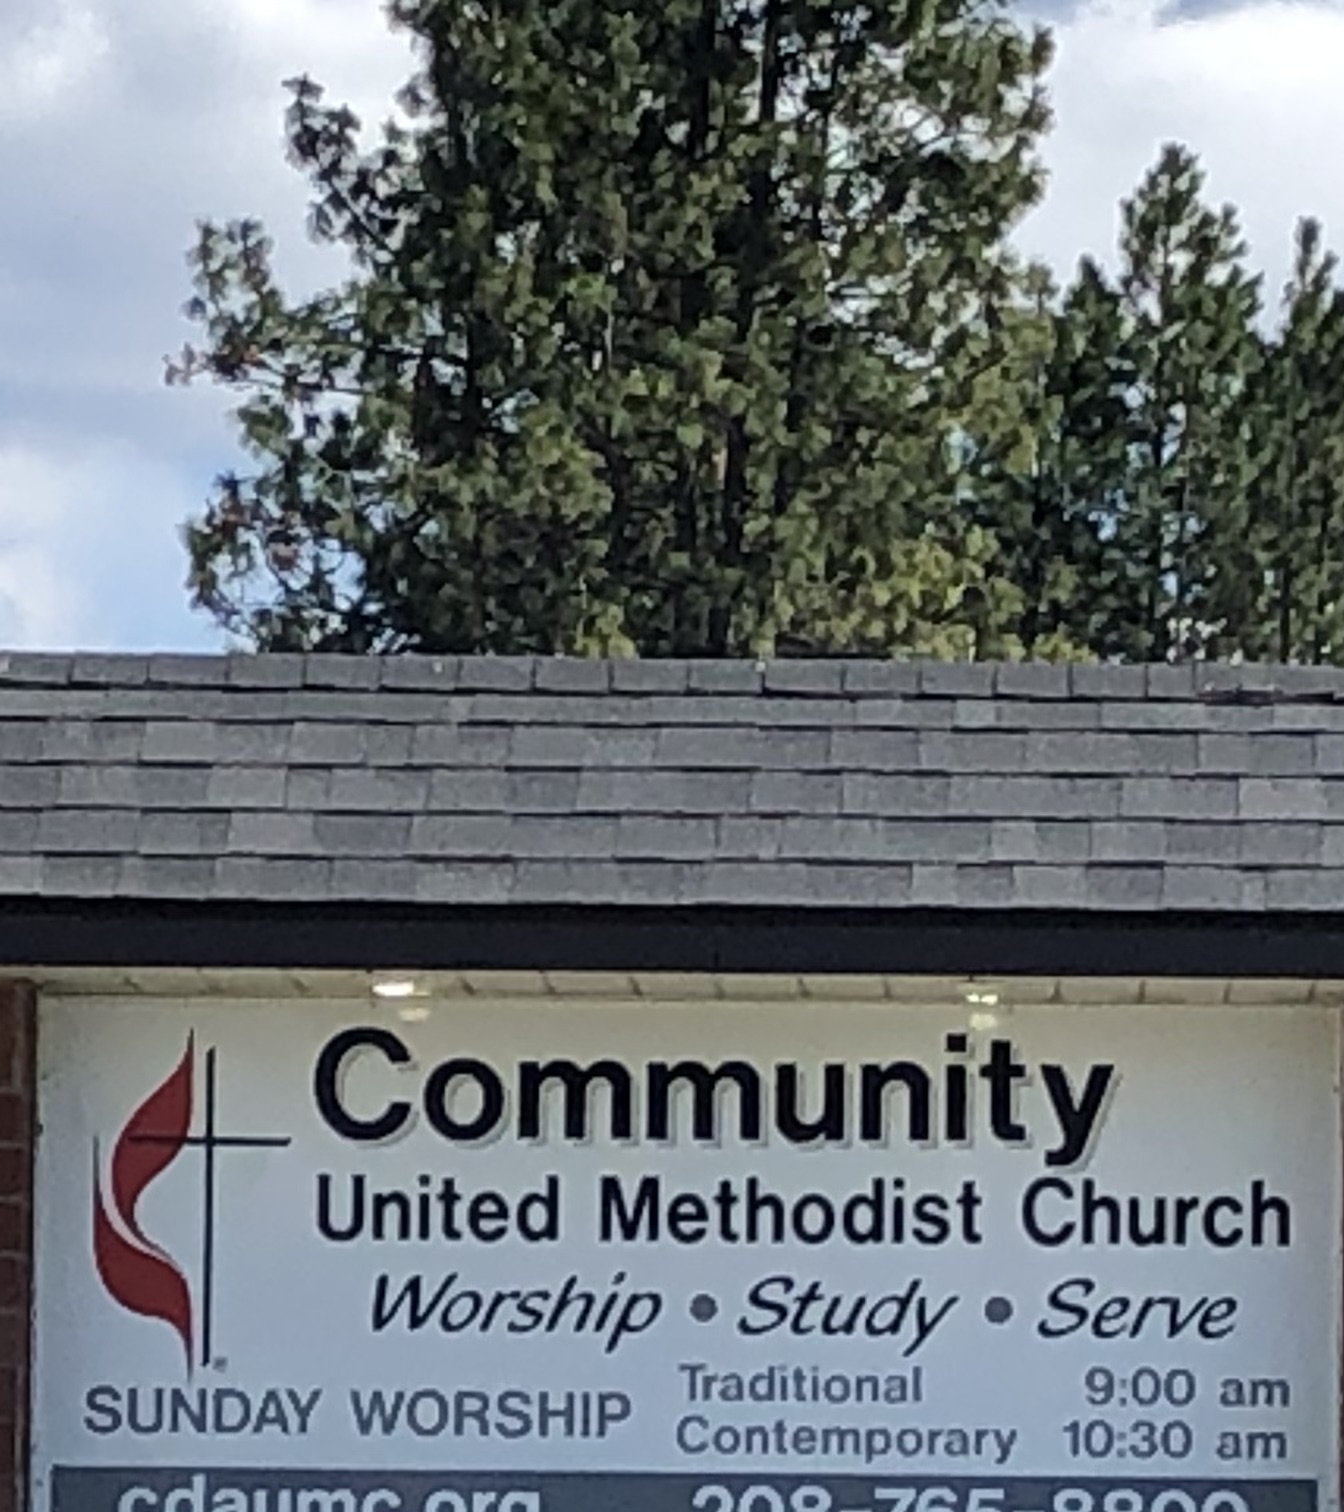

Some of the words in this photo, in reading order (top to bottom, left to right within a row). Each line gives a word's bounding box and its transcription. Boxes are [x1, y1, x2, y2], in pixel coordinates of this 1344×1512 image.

[314, 1027, 1115, 1167] Community
[317, 1173, 559, 1243] United
[600, 1175, 982, 1245] Methodist
[1022, 1176, 1291, 1248] Church
[372, 1271, 663, 1354] Worship
[737, 1276, 959, 1358] Study
[1037, 1278, 1238, 1340] Serve
[83, 1385, 322, 1435] SUNDAY
[350, 1388, 631, 1439] WORSHIP
[678, 1363, 922, 1405] Traditional
[1084, 1366, 1196, 1408] 9:00
[1219, 1378, 1291, 1408] am
[676, 1414, 1018, 1465] Contemporary
[1063, 1419, 1193, 1459] 10:30
[1216, 1431, 1287, 1461] am
